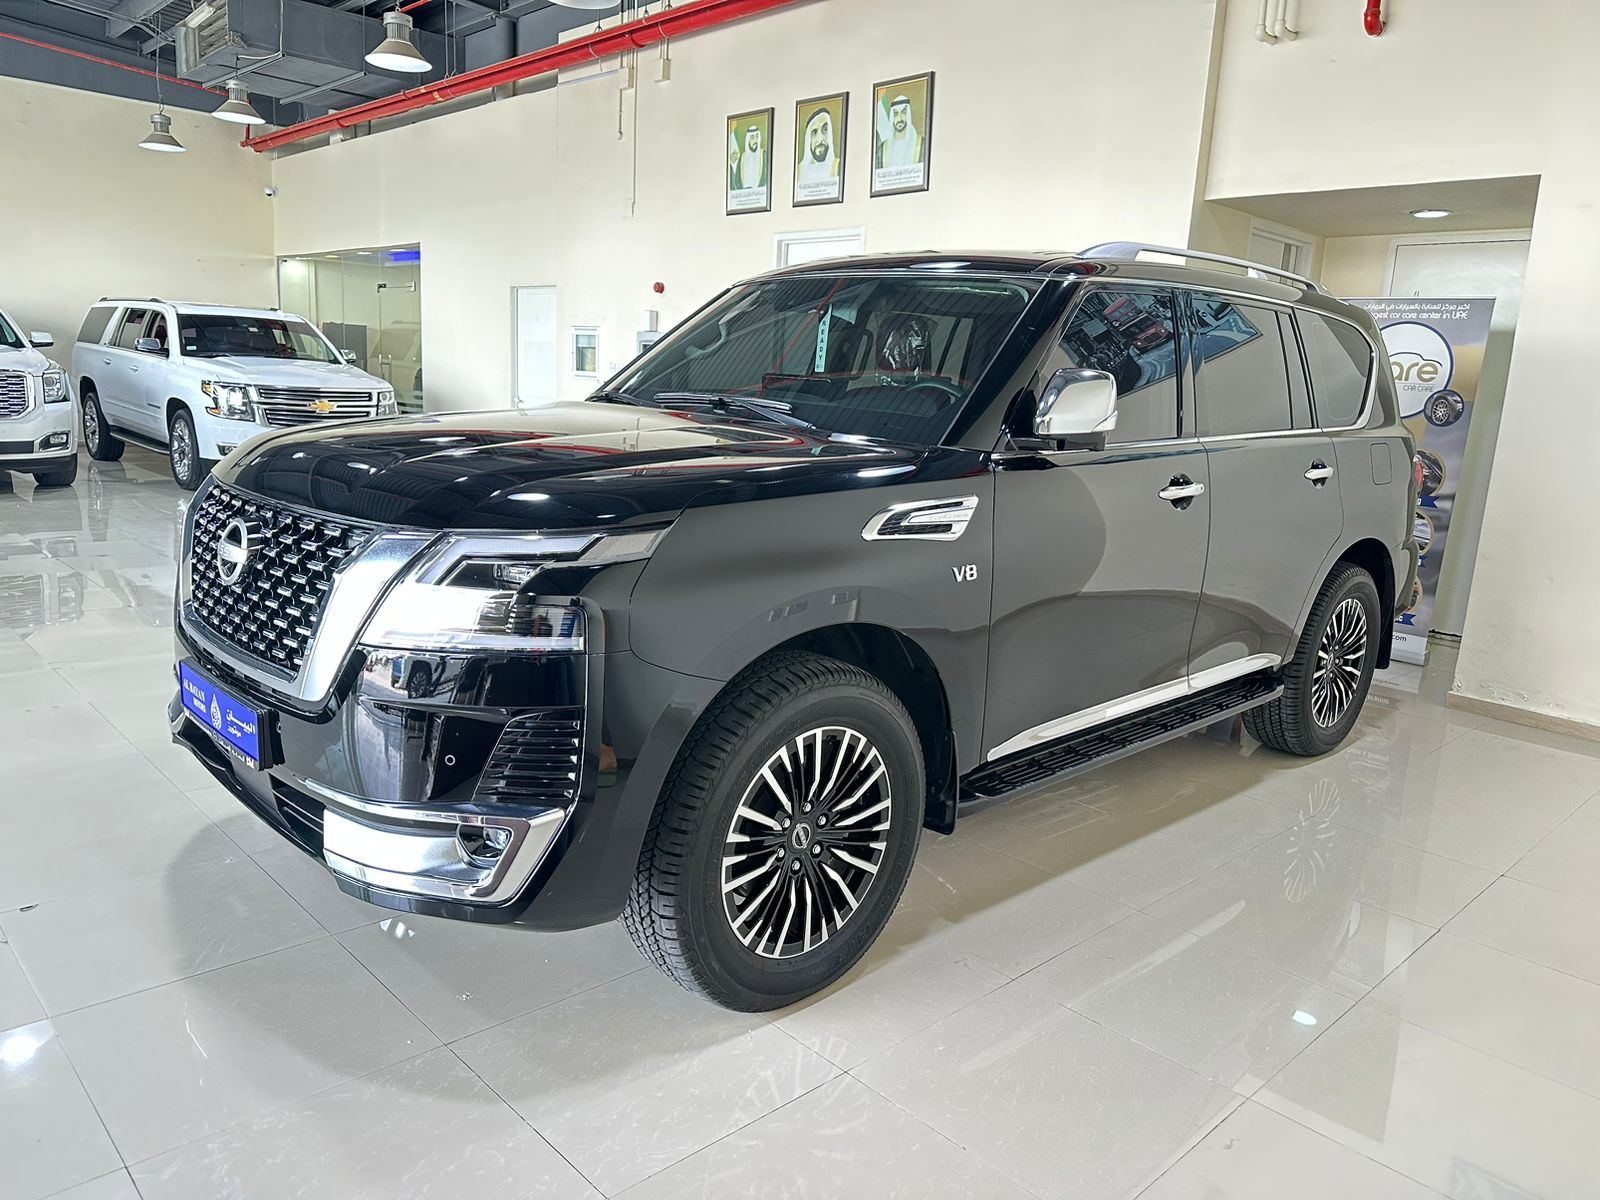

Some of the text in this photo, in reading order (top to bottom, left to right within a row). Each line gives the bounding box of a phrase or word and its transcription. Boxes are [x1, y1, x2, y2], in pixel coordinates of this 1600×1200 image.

[1373, 312, 1389, 320] gest
[1442, 311, 1451, 319] in
[819, 320, 827, 361] READY
[1391, 361, 1439, 383] are
[1402, 384, 1436, 393] CAR CARE
[952, 564, 978, 582] V8
